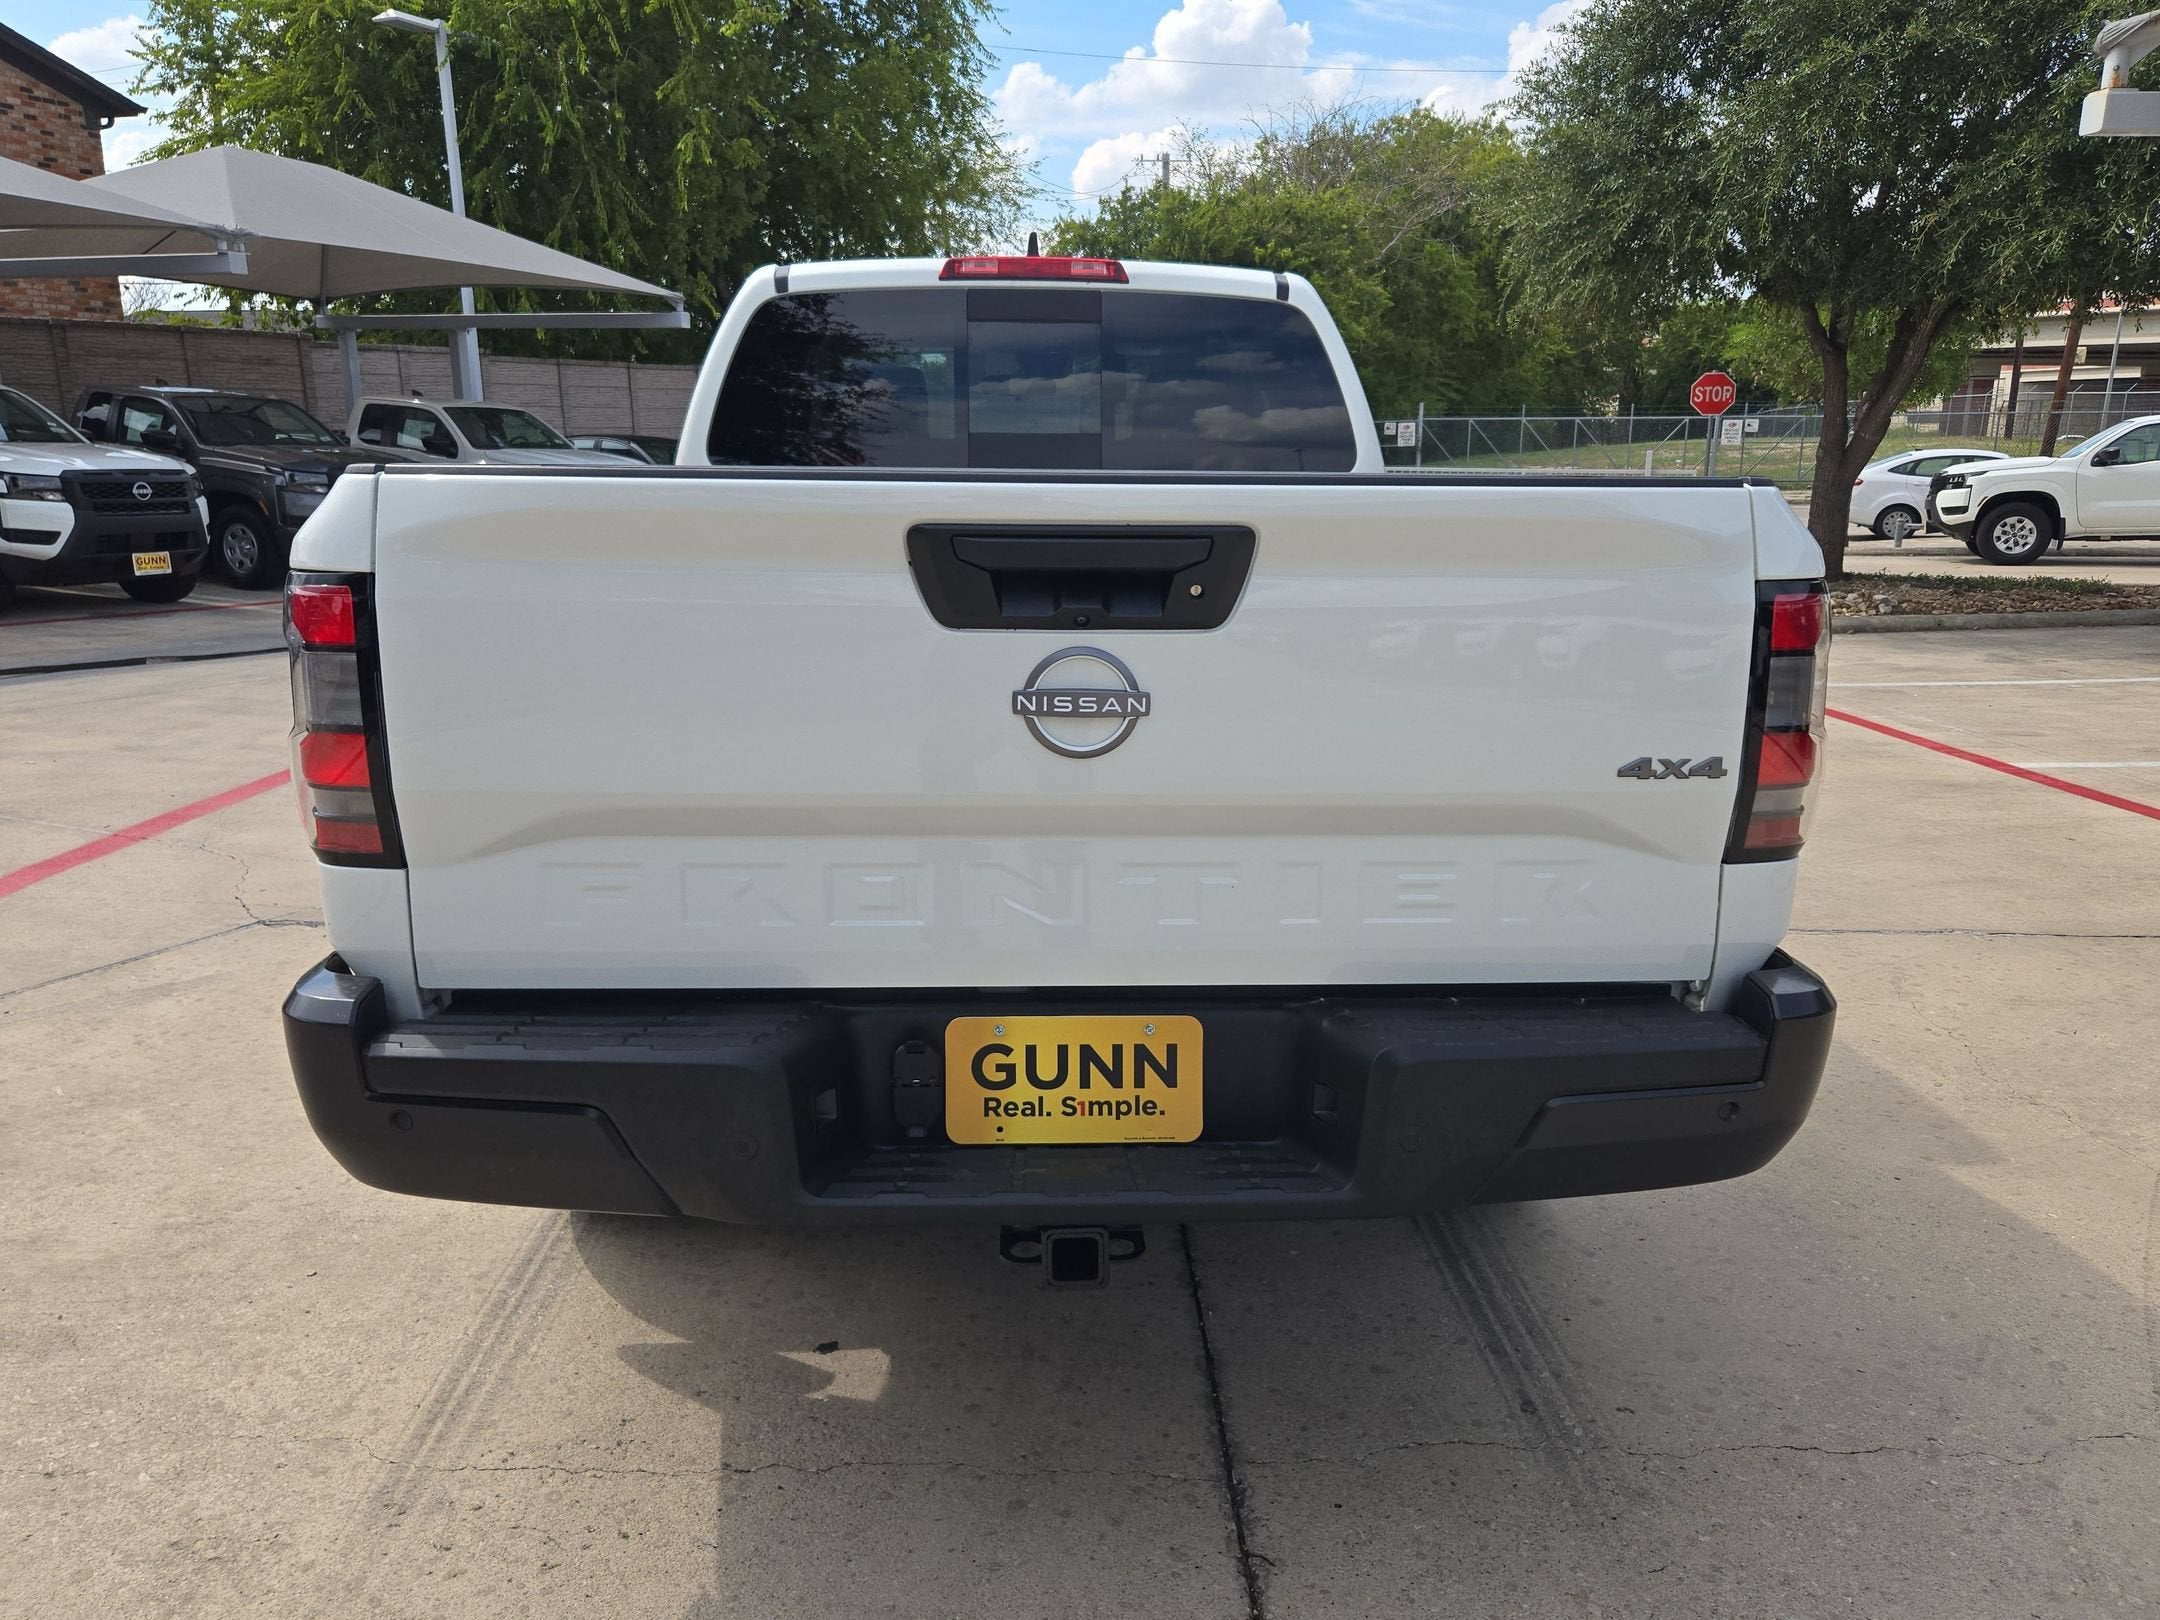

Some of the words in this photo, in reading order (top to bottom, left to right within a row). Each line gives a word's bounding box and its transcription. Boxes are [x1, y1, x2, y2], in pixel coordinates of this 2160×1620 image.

[1694, 386, 1733, 402] STOP
[136, 556, 166, 566] GUNN
[1016, 695, 1147, 713] NISSAN
[538, 862, 1601, 927] FRONTIER
[971, 1043, 1178, 1091] GUNN
[983, 1096, 1052, 1118] Real.
